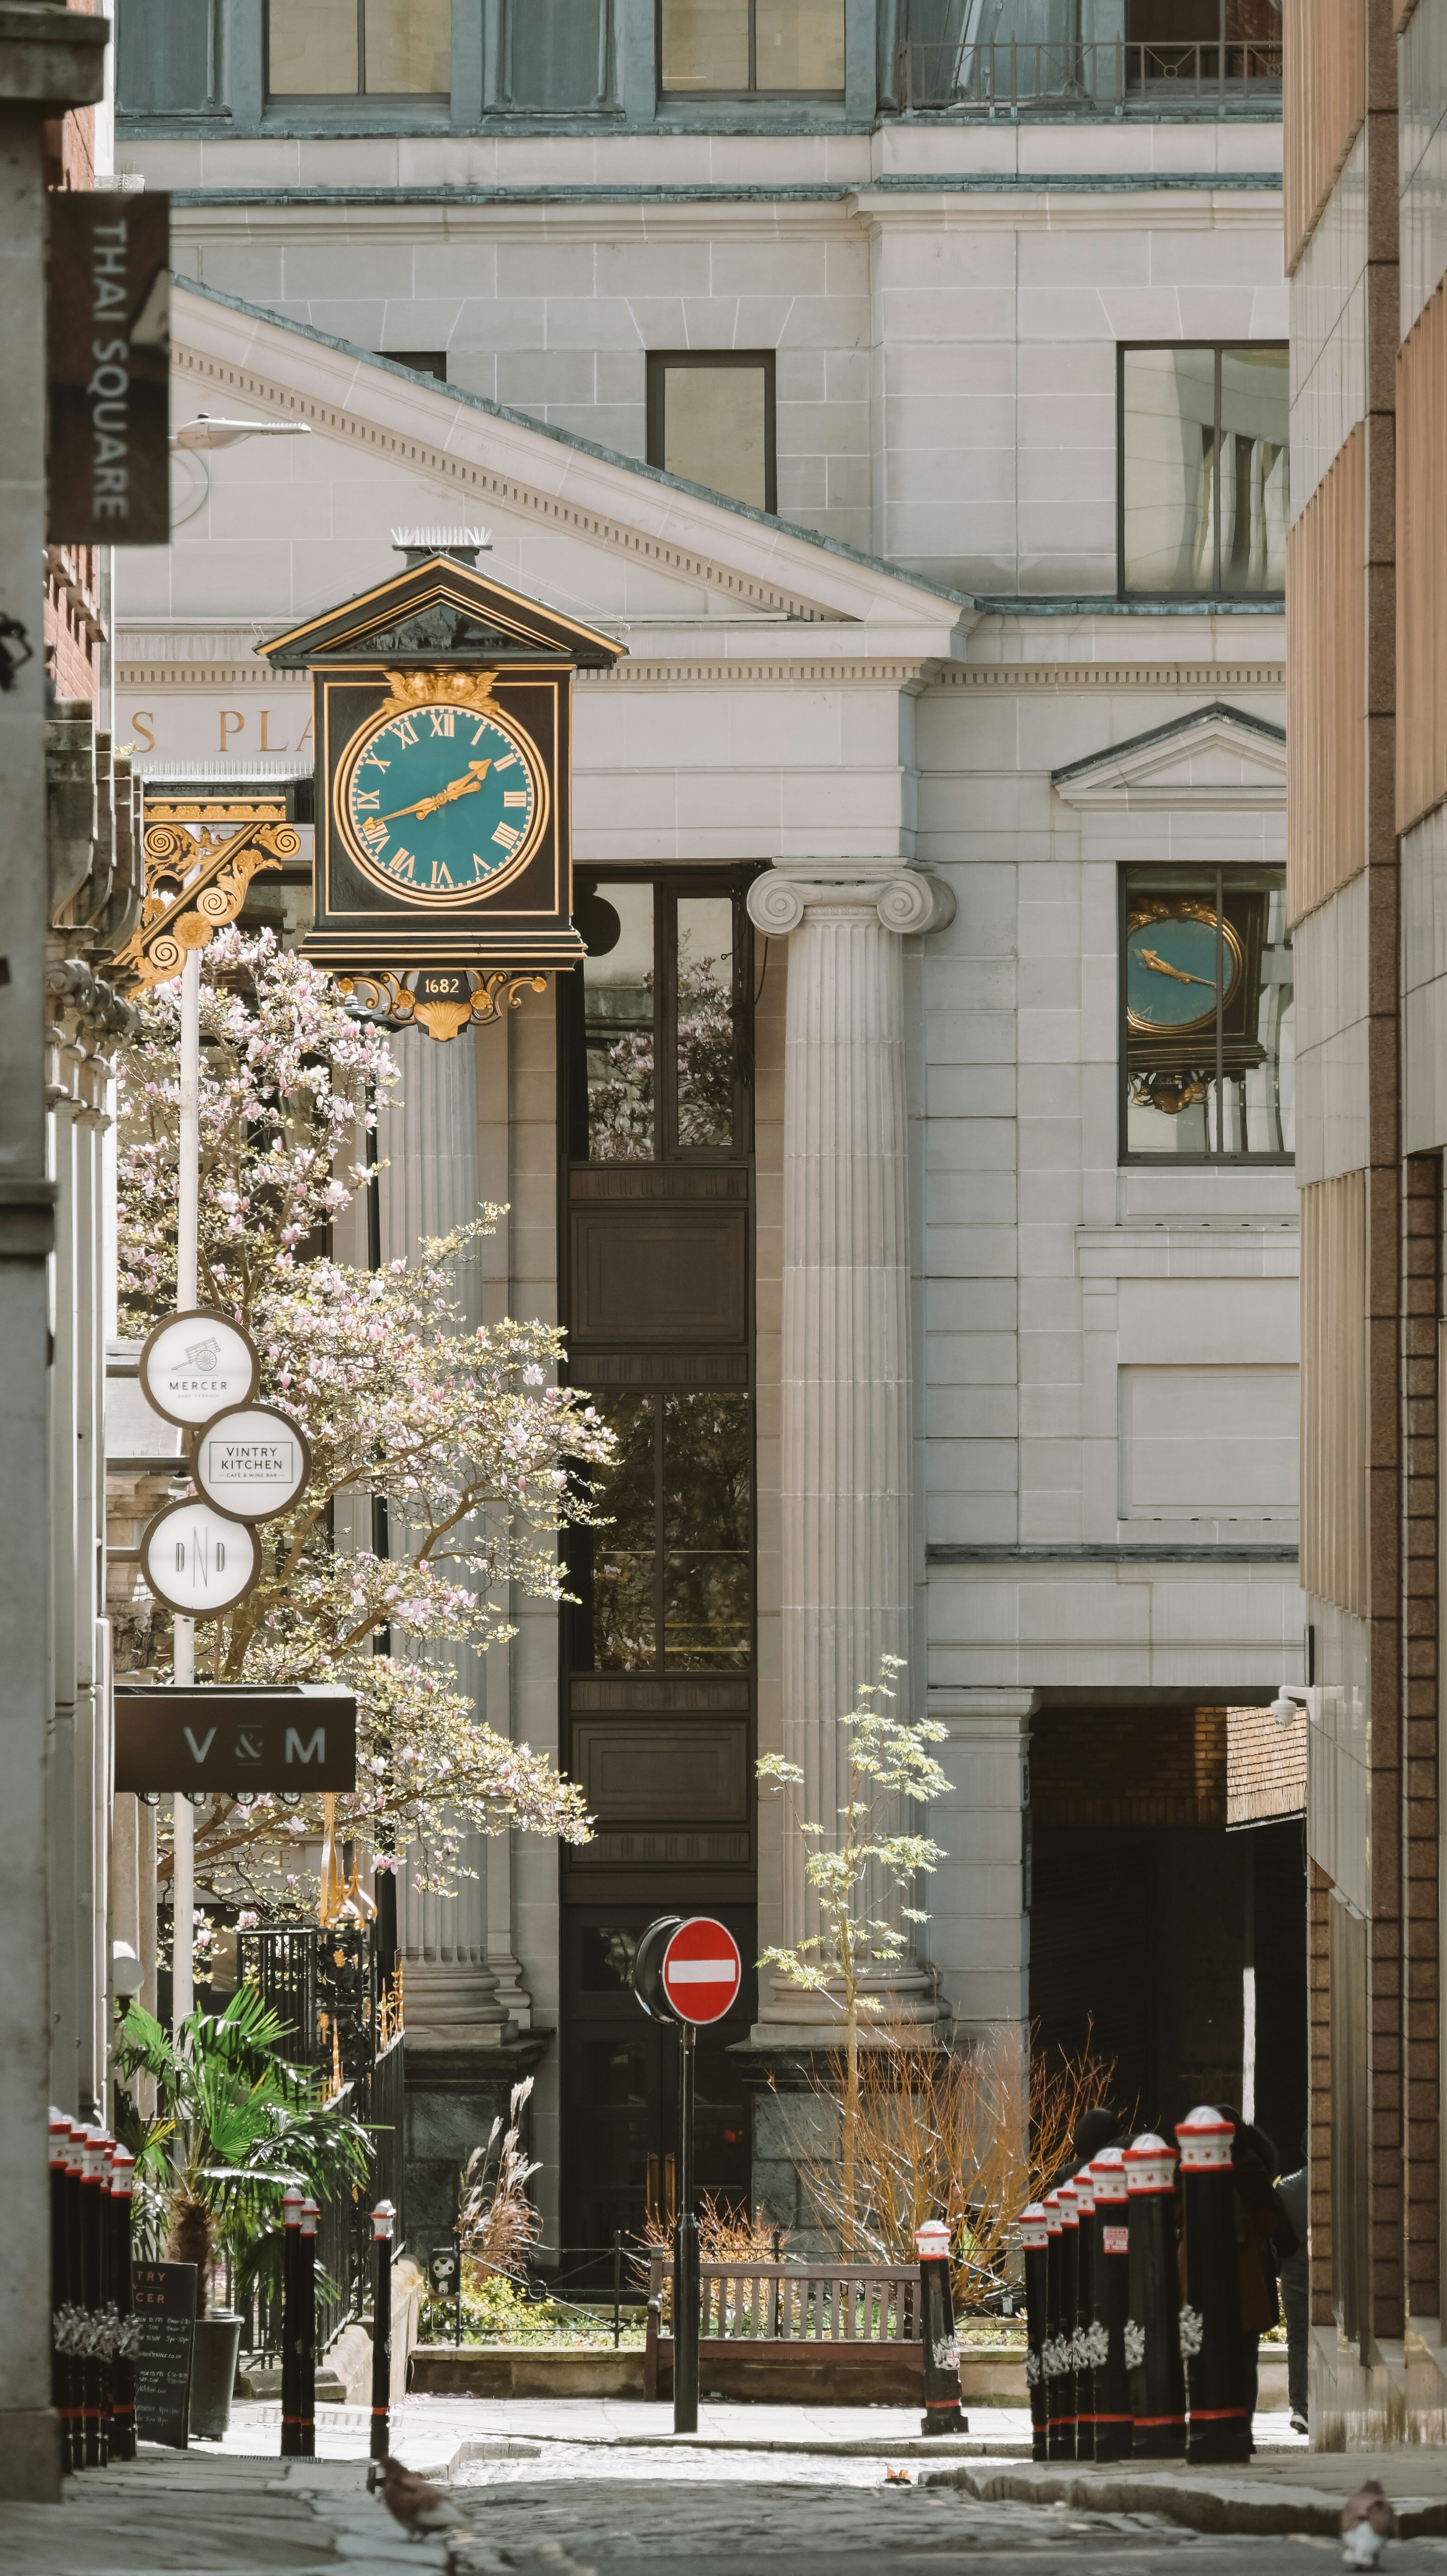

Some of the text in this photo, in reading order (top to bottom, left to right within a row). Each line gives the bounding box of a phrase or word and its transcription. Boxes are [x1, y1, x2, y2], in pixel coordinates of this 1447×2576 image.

[87, 219, 128, 518] THAI SQUARE
[391, 720, 420, 750] XI
[429, 713, 455, 737] XII
[470, 725, 486, 745] I
[365, 751, 391, 775] X
[493, 752, 517, 772] II
[357, 789, 380, 809] IX
[504, 791, 526, 807] III
[389, 847, 415, 878] VII
[431, 861, 453, 884] VI
[473, 853, 491, 876] V
[425, 978, 459, 993] 1682
[226, 1448, 277, 1457] VINTRY
[222, 1460, 282, 1469] KITCHEN
[184, 1726, 325, 1763] V & M
